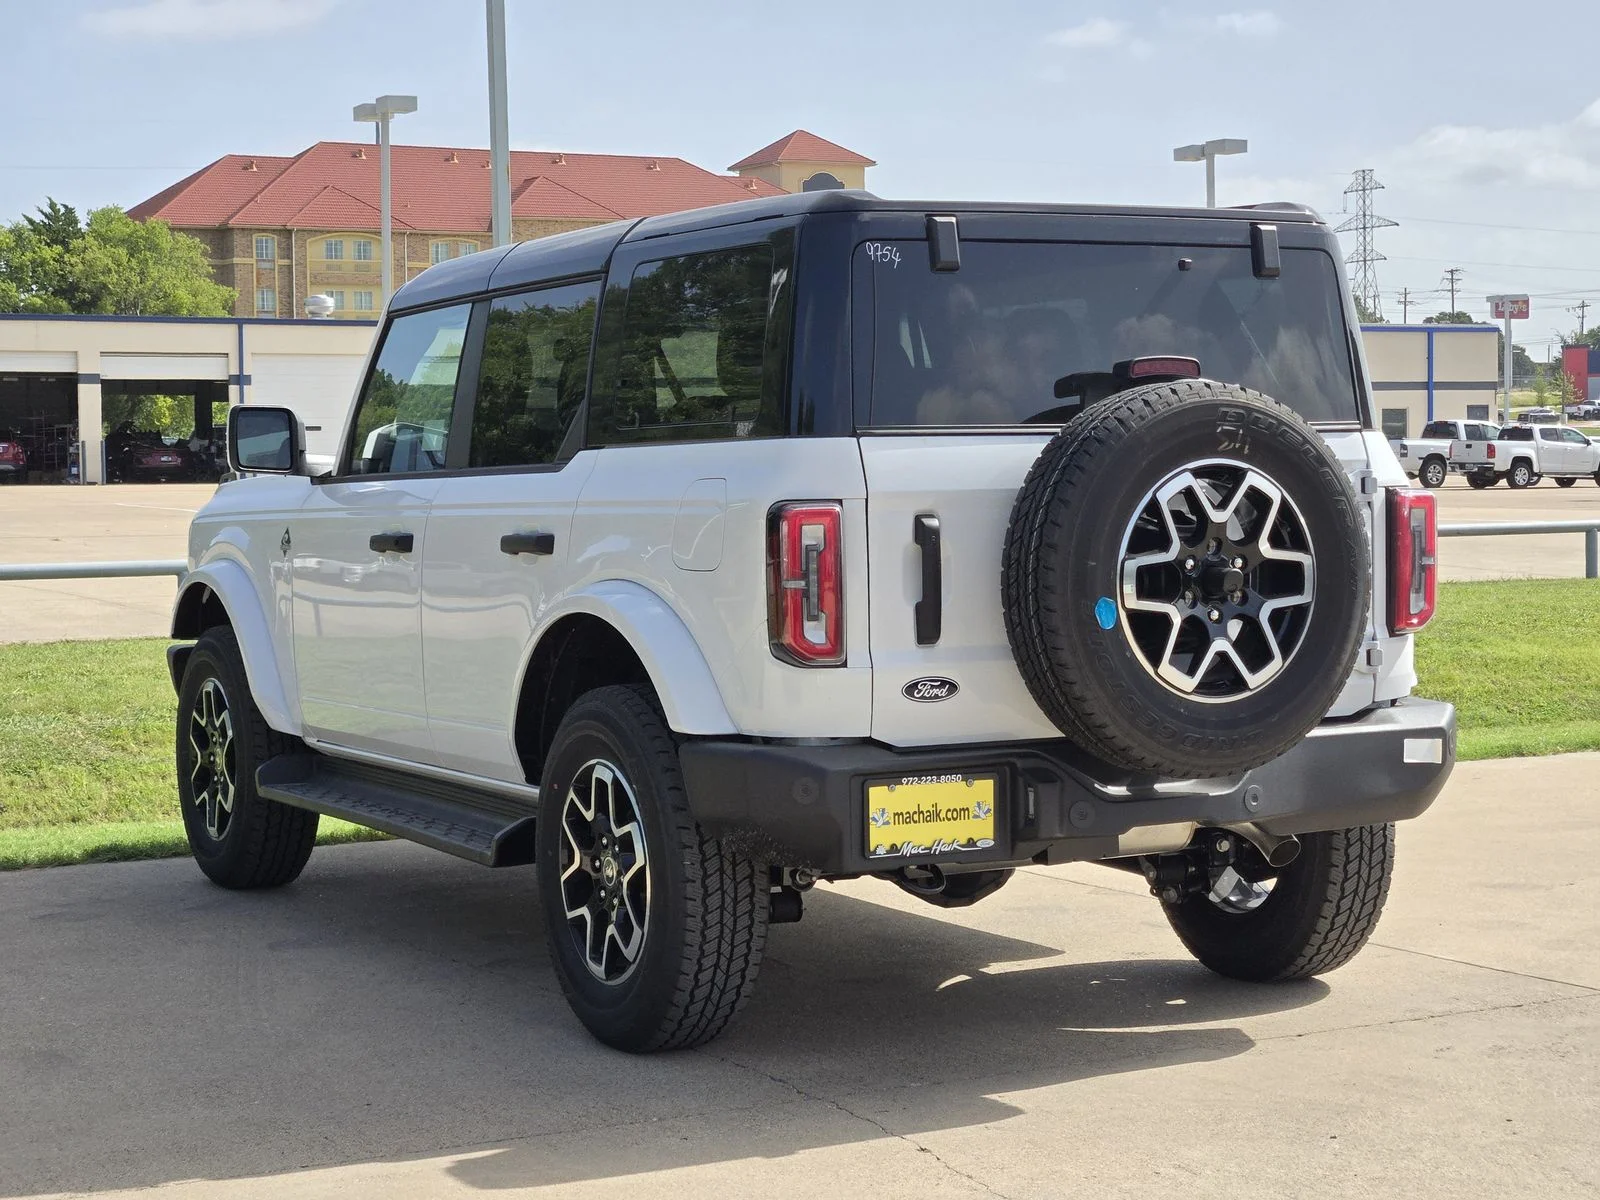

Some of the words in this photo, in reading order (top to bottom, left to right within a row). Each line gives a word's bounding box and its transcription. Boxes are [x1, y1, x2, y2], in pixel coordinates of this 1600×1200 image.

[866, 241, 901, 269] 9754
[914, 681, 949, 698] Ford
[901, 774, 962, 786] 972-223-8050
[893, 802, 970, 826] machaik.com
[899, 841, 930, 857] Mac
[931, 837, 963, 855] Haik
